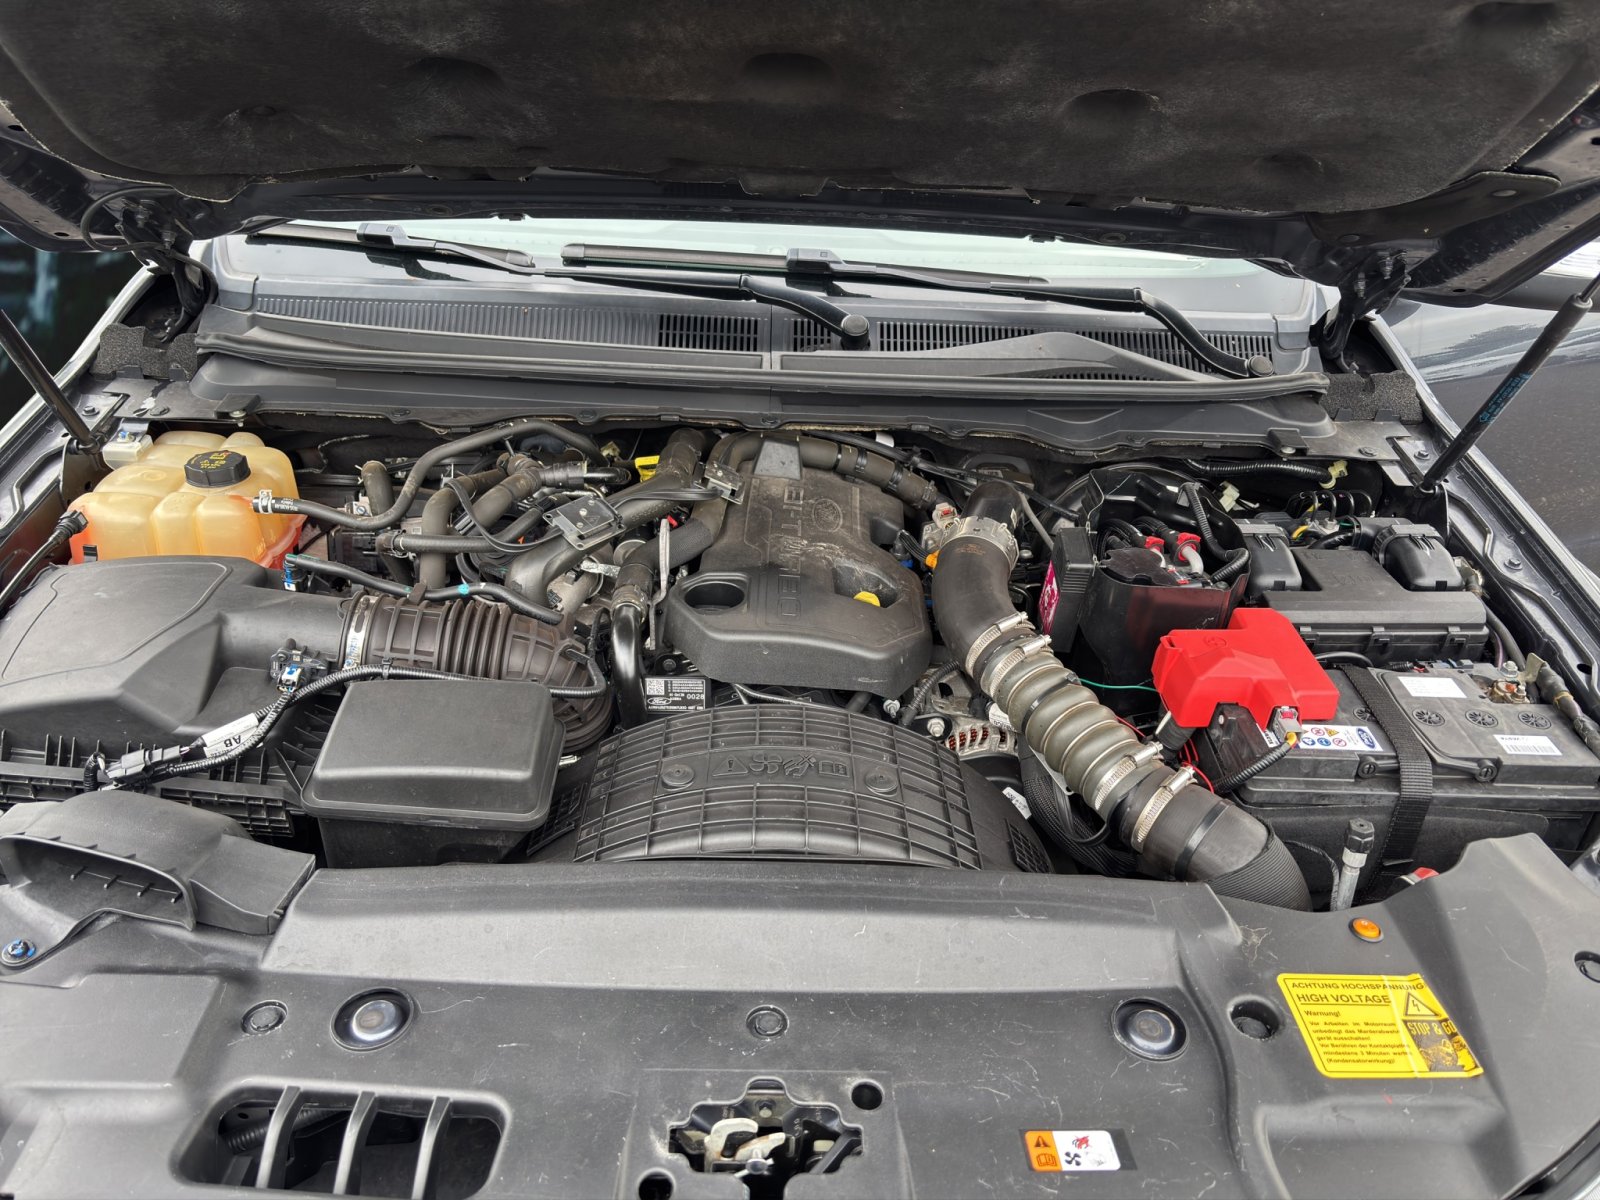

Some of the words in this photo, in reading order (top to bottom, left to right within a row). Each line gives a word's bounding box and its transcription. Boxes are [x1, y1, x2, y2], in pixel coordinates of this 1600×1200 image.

[224, 735, 241, 747] AB
[1341, 982, 1424, 990] HOCHSPANNUNG
[1296, 993, 1330, 1002] HIGH
[1331, 994, 1391, 1003] VOLTAGE
[1407, 1022, 1431, 1035] STOP
[1432, 1022, 1443, 1034] &
[1441, 1020, 1457, 1034] GO
